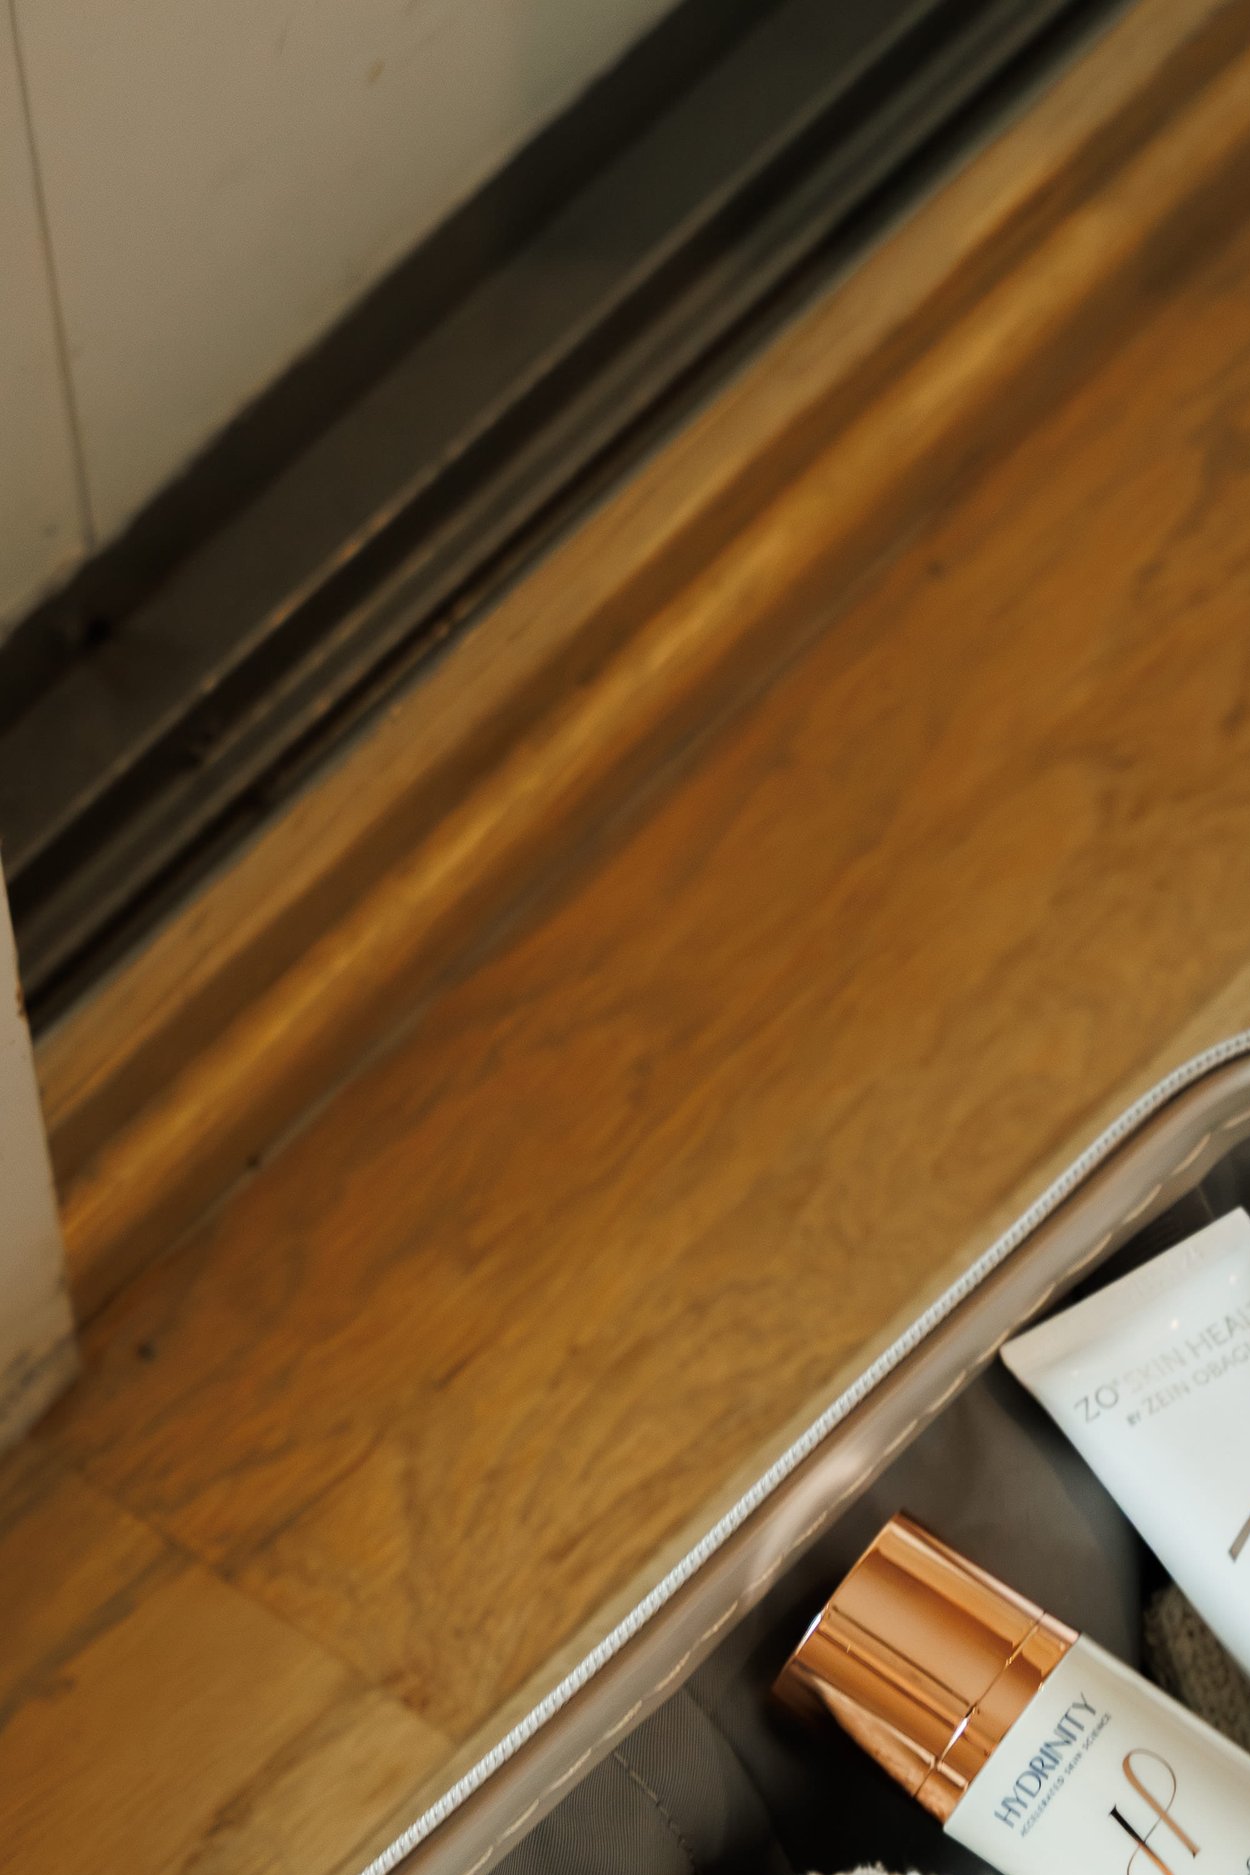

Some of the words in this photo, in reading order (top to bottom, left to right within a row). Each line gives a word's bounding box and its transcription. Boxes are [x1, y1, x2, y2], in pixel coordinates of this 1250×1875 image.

[1122, 1346, 1188, 1394] SKIN
[1141, 1380, 1192, 1417] ZEIN
[993, 1692, 1097, 1829] HYDRINITY
[1063, 1751, 1083, 1776] SKIN
[1081, 1712, 1112, 1751] SCIENCE
